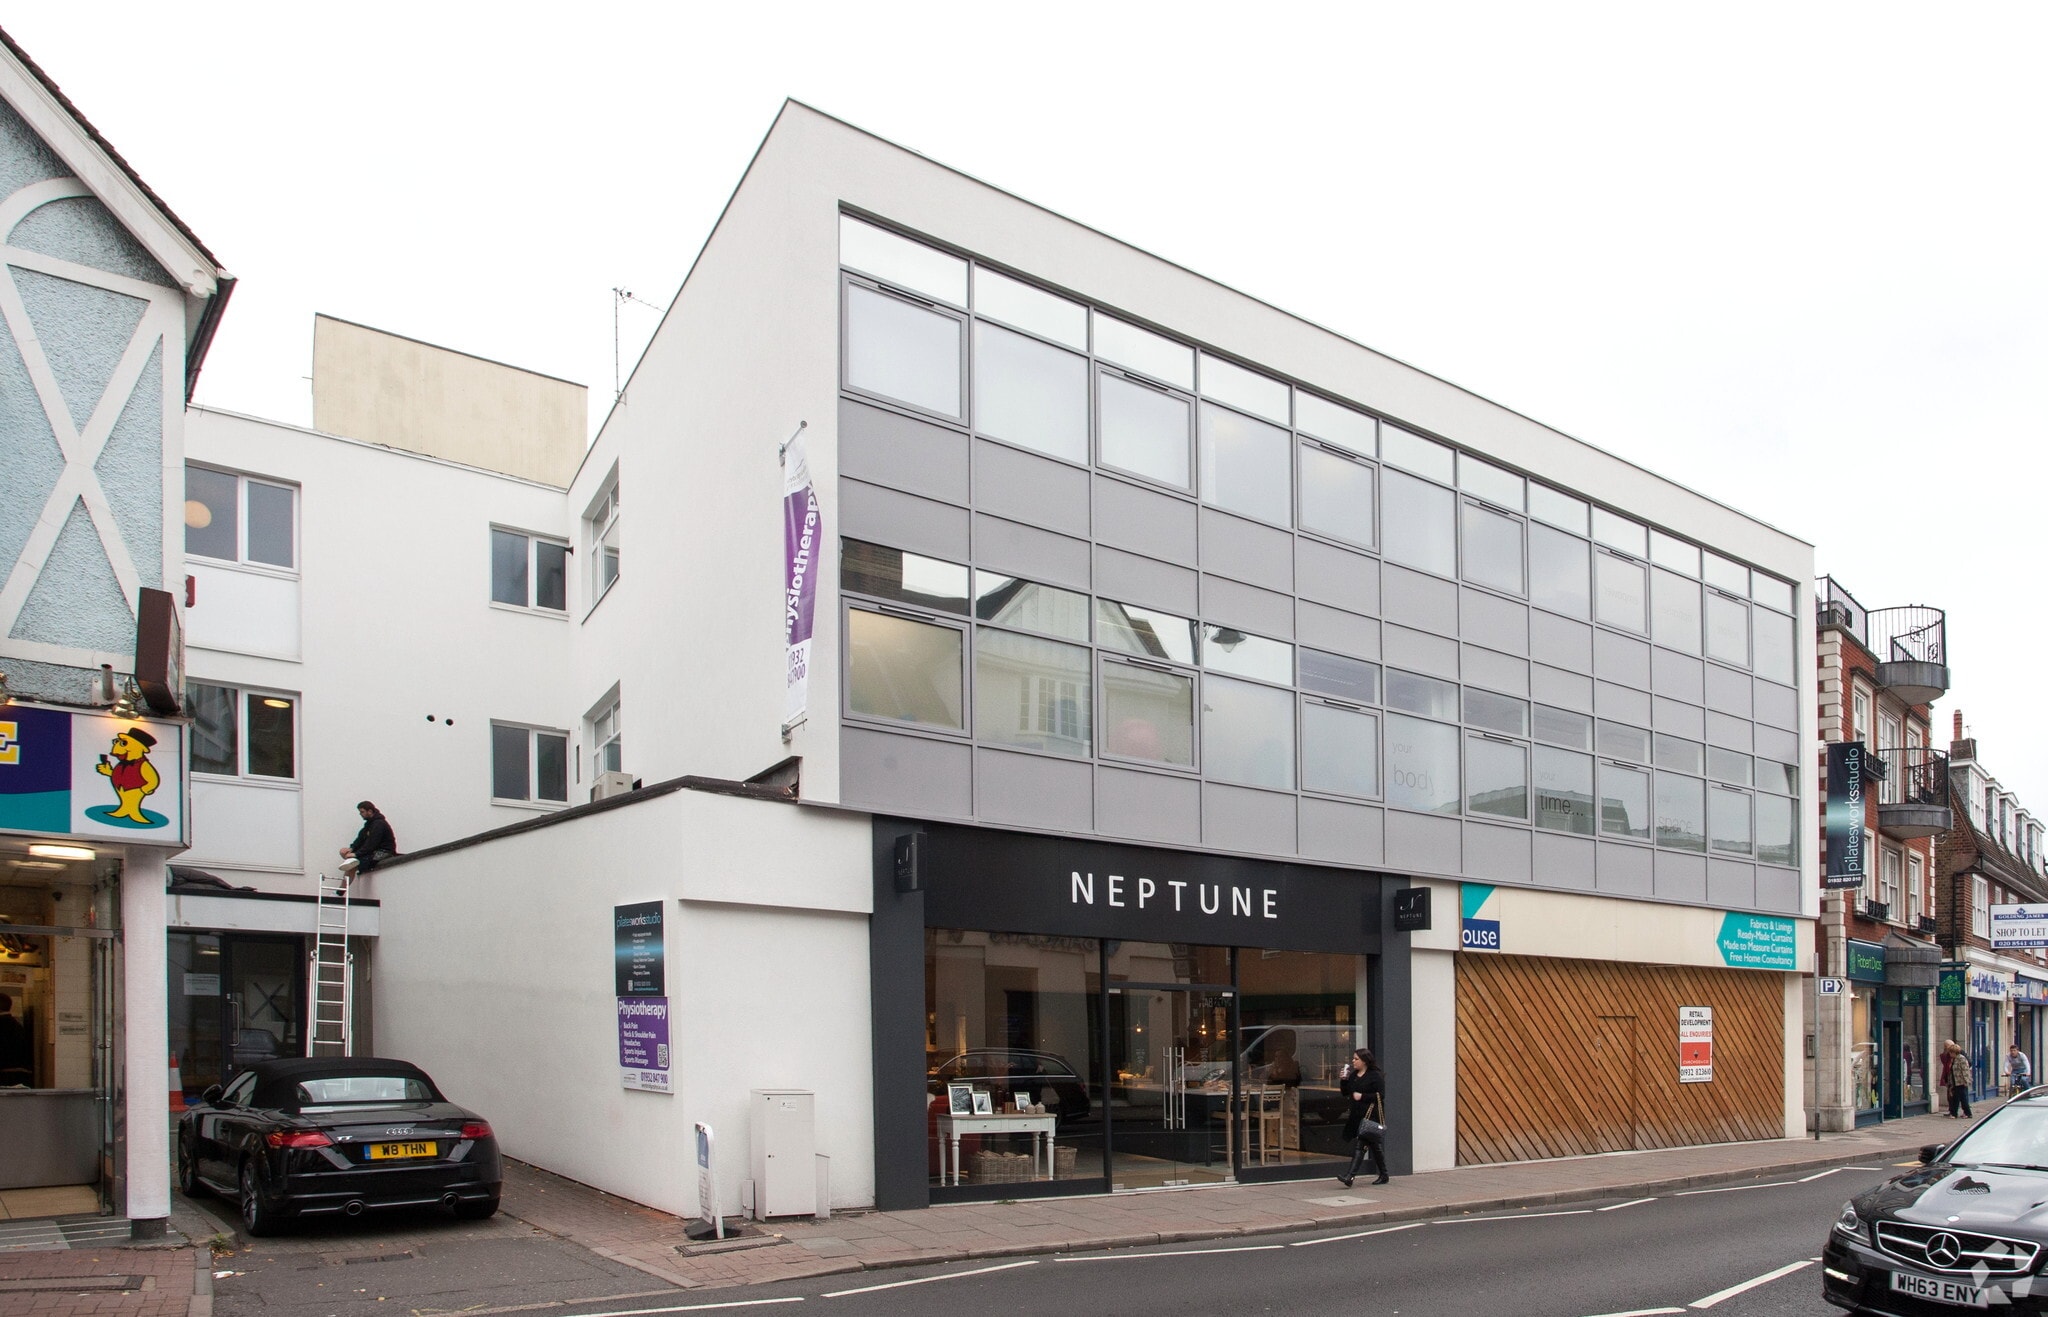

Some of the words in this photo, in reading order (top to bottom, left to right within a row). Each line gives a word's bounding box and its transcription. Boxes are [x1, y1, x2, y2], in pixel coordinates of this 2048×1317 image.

[1844, 748, 1862, 872] pilatesworksstudio
[1071, 871, 1278, 919] NEPTUNE
[1750, 918, 1769, 930] Fabrics
[1769, 920, 1775, 930] &
[1775, 921, 1793, 934] Linings
[1996, 928, 2017, 937] SHOP
[2018, 928, 2030, 937] TO
[2031, 927, 2047, 936] LET
[1462, 929, 1497, 946] ouse
[1737, 928, 1770, 941] Ready-Made
[1770, 932, 1793, 943] Curtains
[1723, 940, 1739, 950] Made
[1740, 942, 1747, 950] to
[1747, 941, 1770, 952] Measure
[1770, 943, 1793, 954] Curtains
[1729, 952, 1743, 961] Free
[1743, 953, 1761, 963] Home
[1761, 954, 1793, 967] Consultancy
[1825, 981, 1833, 992] P
[618, 1000, 667, 1020] Physiotherapy
[634, 1031, 649, 1039] Shoulder
[624, 1048, 634, 1056] Sports
[624, 1056, 635, 1064] Sports
[1681, 1068, 1694, 1076] 01932
[382, 1144, 399, 1156] W8
[402, 1143, 428, 1155] THN
[1897, 1273, 1939, 1297] WH63
[1943, 1284, 1982, 1304] ENY
